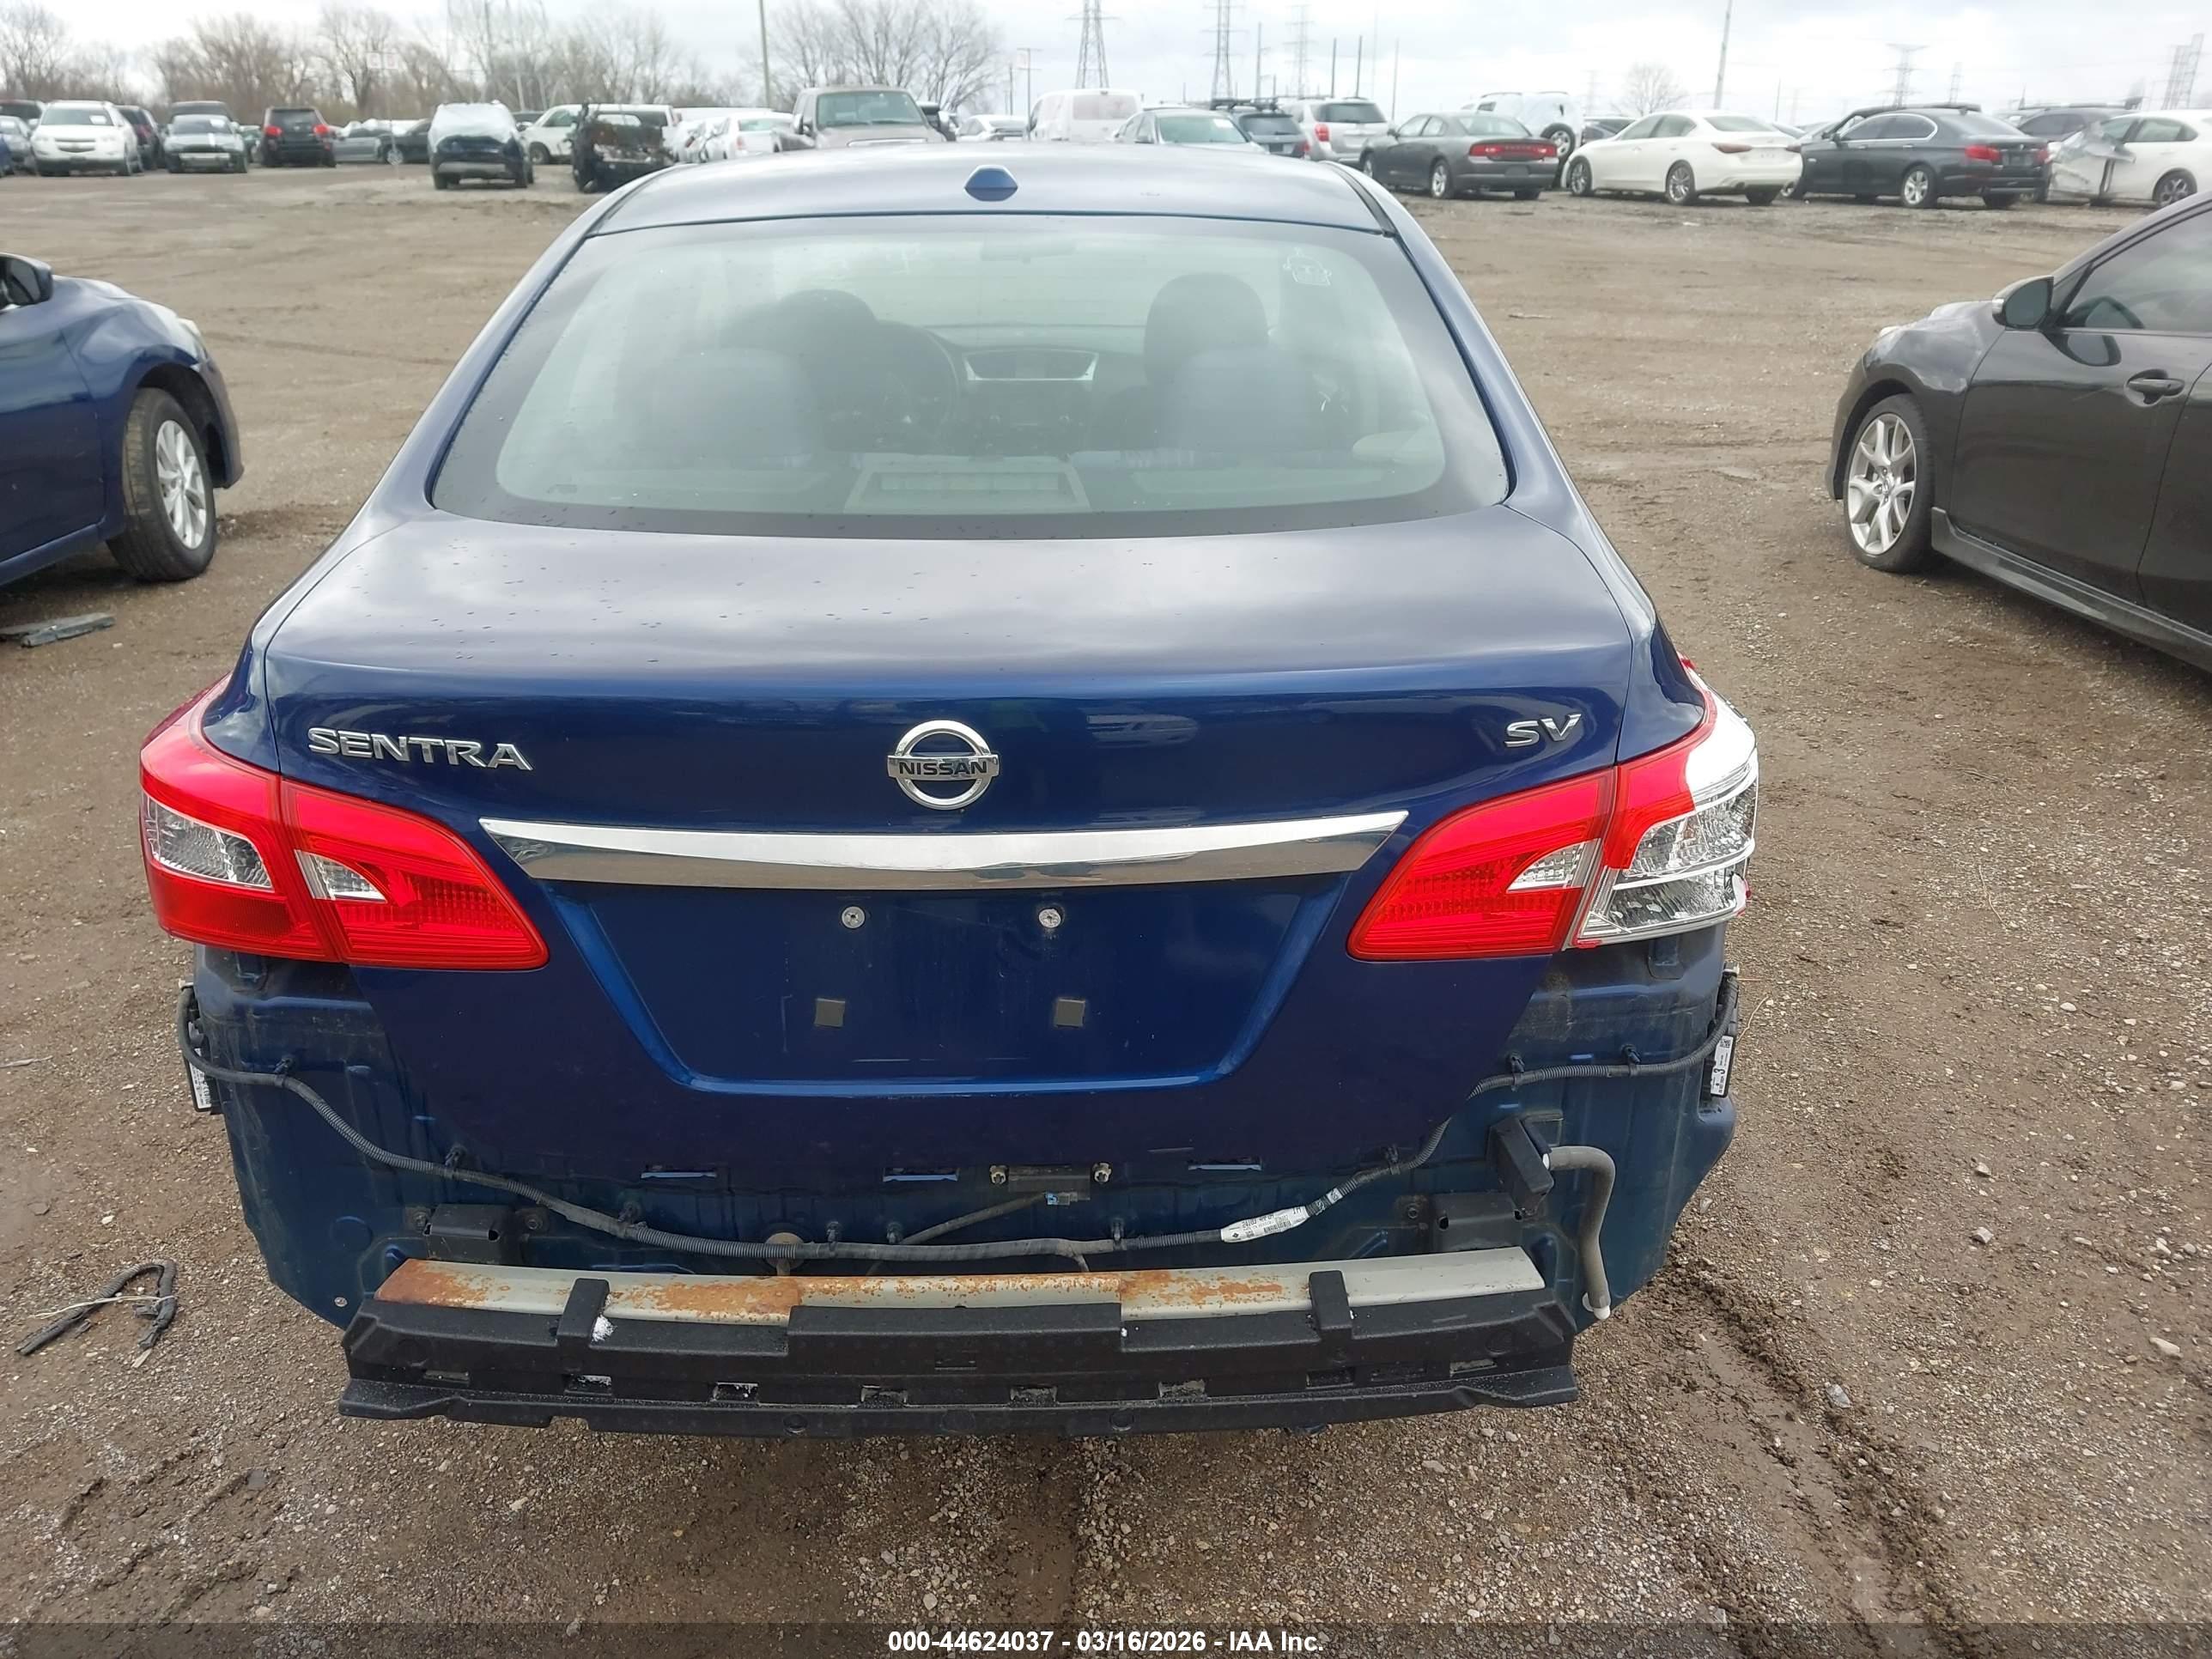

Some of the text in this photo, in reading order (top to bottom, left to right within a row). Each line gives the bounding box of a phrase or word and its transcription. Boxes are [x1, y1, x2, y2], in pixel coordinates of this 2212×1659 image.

[1504, 714, 1582, 747] SV
[307, 727, 533, 771] SENTRA
[898, 761, 988, 775] NISSAN
